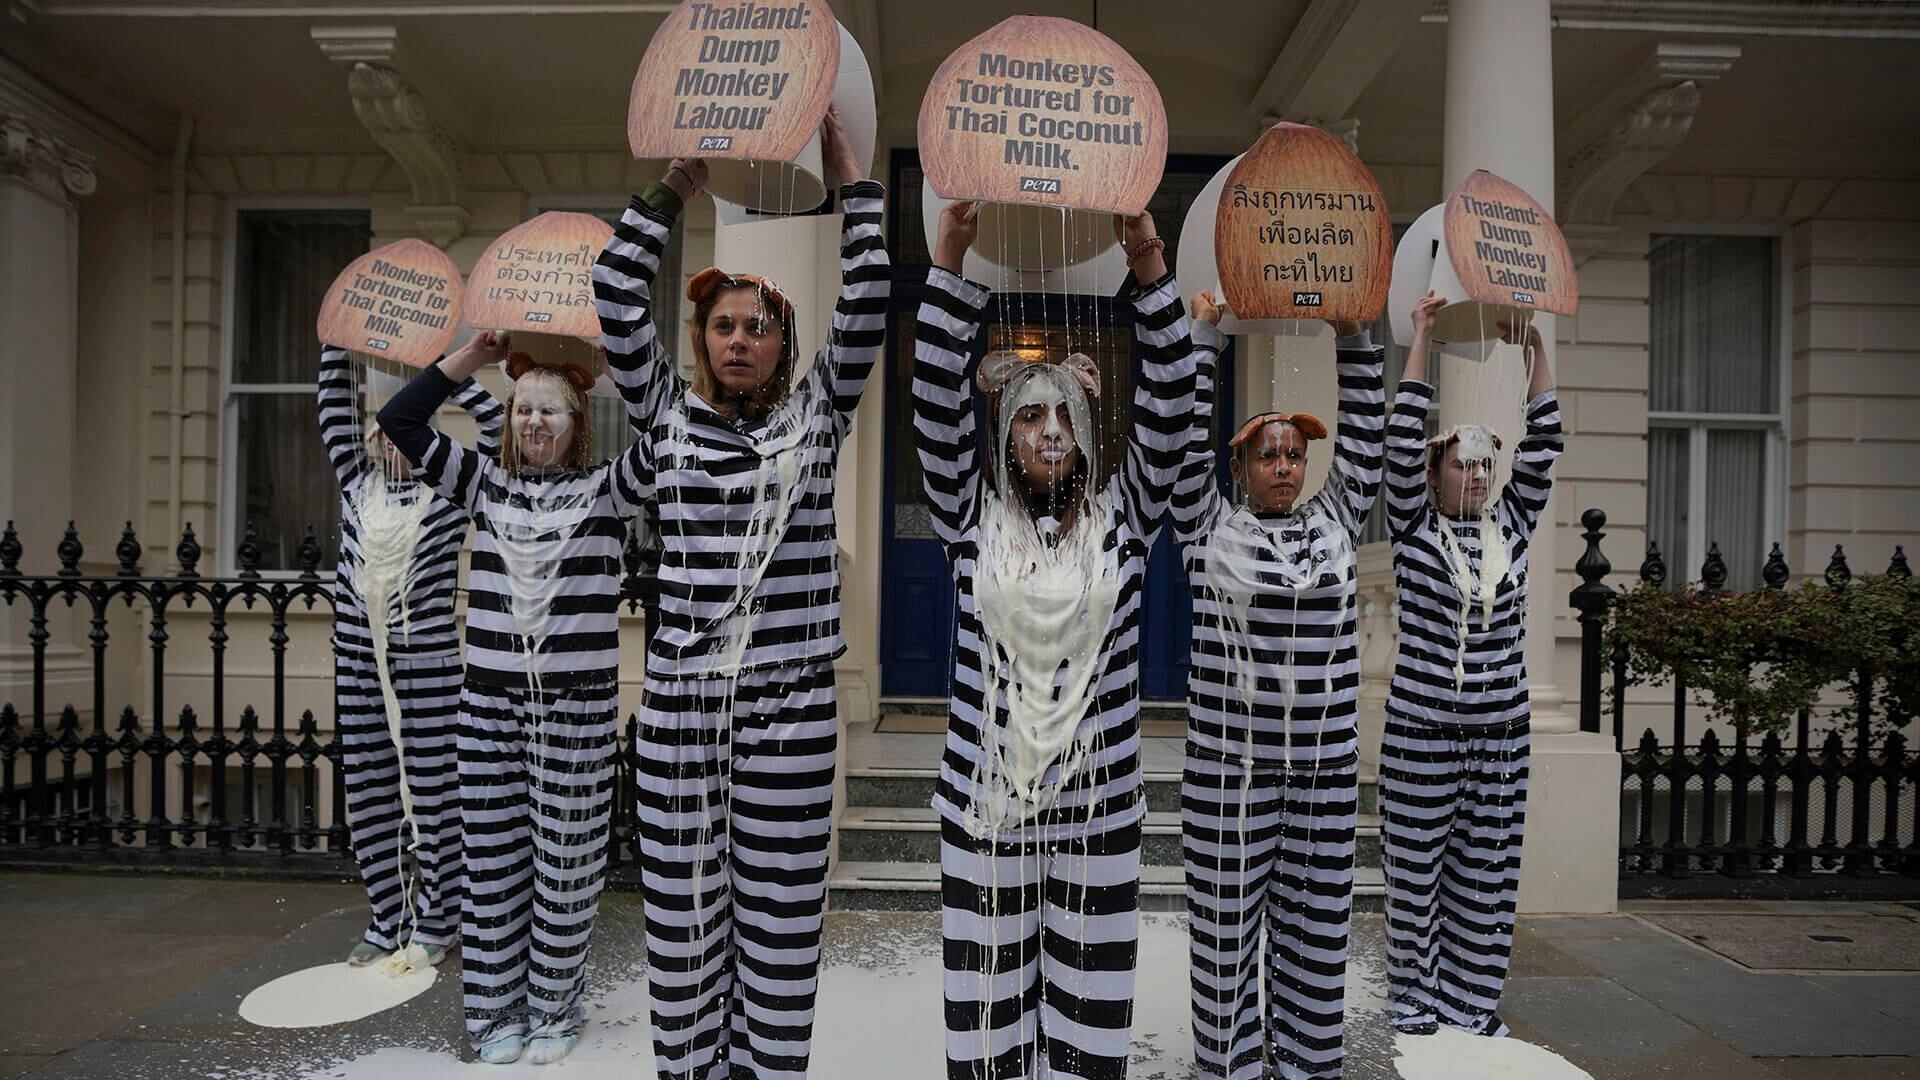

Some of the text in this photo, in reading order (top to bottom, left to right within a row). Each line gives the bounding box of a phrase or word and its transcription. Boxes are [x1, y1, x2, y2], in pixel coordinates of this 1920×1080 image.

[689, 3, 812, 31] Thailand:
[698, 35, 781, 66] Dump
[674, 68, 790, 100] Monkey
[978, 53, 1115, 88] Monkeys
[956, 78, 1135, 117] Tortured for
[673, 102, 772, 131] Labour
[945, 105, 1144, 147] Thai Coconut
[1004, 139, 1080, 171] Milk.
[1233, 183, 1376, 216] ลิงถูกทรมาน
[1460, 195, 1542, 227] Thailand:
[1259, 214, 1354, 246] เพื่อผลิต
[1479, 219, 1534, 248] Dump
[1263, 252, 1354, 283] กะทิไทย
[1475, 240, 1547, 274] Monkey
[370, 259, 448, 292] Monkeys
[1485, 265, 1547, 293] Labour
[352, 273, 451, 312] Tortured for
[340, 289, 449, 330] Thai Coconut
[363, 315, 404, 339] Milk.
